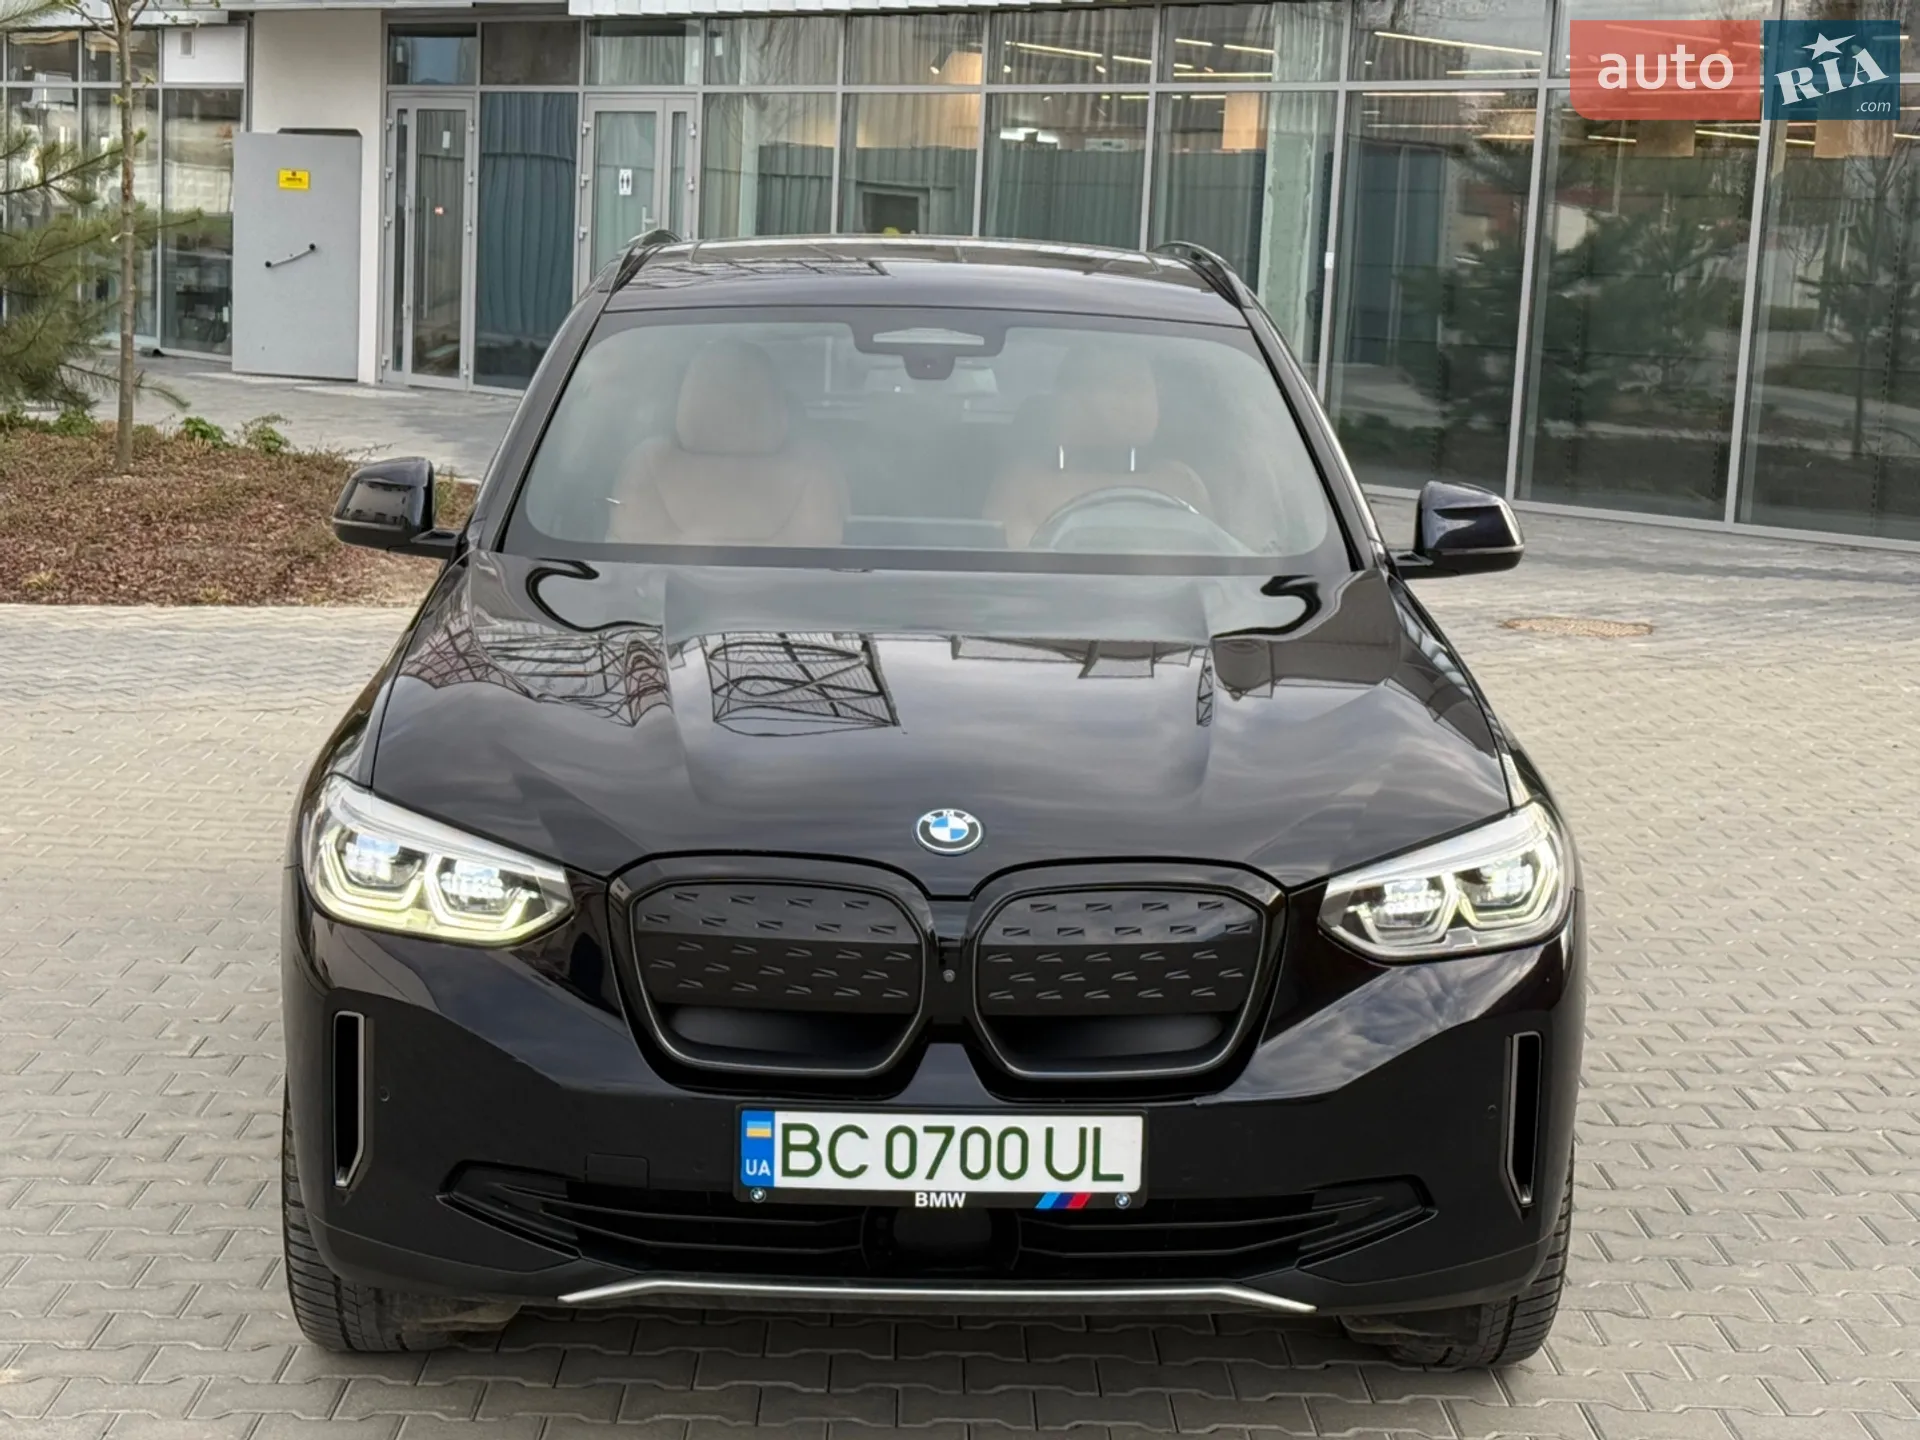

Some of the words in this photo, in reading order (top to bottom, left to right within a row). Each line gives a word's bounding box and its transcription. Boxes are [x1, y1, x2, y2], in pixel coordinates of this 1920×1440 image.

[781, 1122, 869, 1179] BC
[885, 1125, 1029, 1181] 0700
[1044, 1126, 1124, 1182] UL
[746, 1159, 771, 1176] UA
[914, 1191, 967, 1208] BMW
